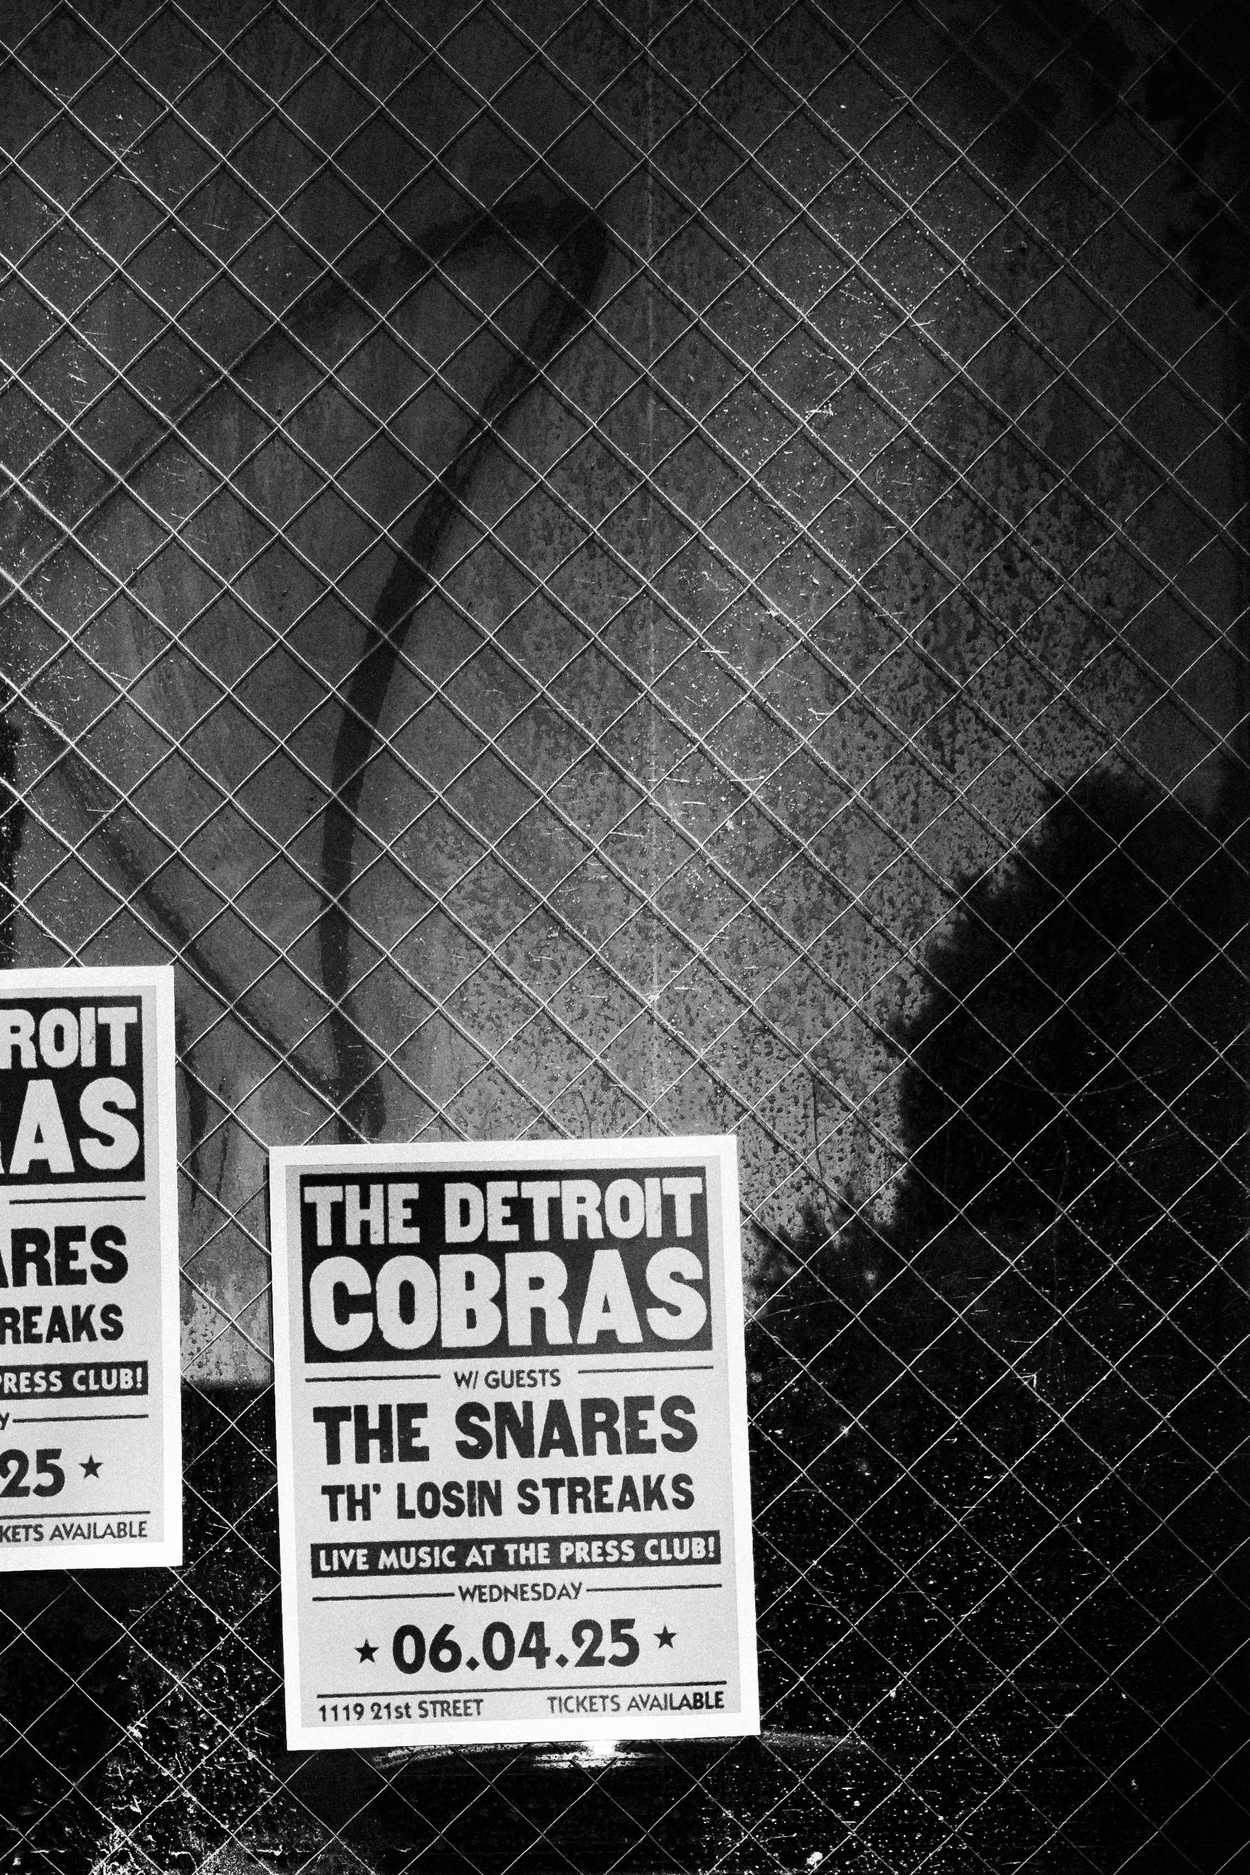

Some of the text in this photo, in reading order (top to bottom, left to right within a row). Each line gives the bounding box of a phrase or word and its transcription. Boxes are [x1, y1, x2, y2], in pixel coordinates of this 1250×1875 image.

[304, 1176, 703, 1246] THE DETROIT
[309, 1247, 708, 1351] COBRAS
[73, 1367, 142, 1391] CLUB!
[453, 1368, 561, 1390] W/ GUESTS
[313, 1395, 698, 1465] THE SNARES
[321, 1473, 695, 1522] TH' LOSIN STREAKS
[49, 1520, 148, 1541] AVAILABLE
[319, 1537, 714, 1571] LIVE MUSIC AT THE PRESS CLUB!
[458, 1582, 582, 1603] WEDNESDAY
[392, 1618, 640, 1675] 06.04.25
[319, 1698, 484, 1722] 1119 21st STREET
[547, 1690, 725, 1713] TICKETS AVAILABLE
